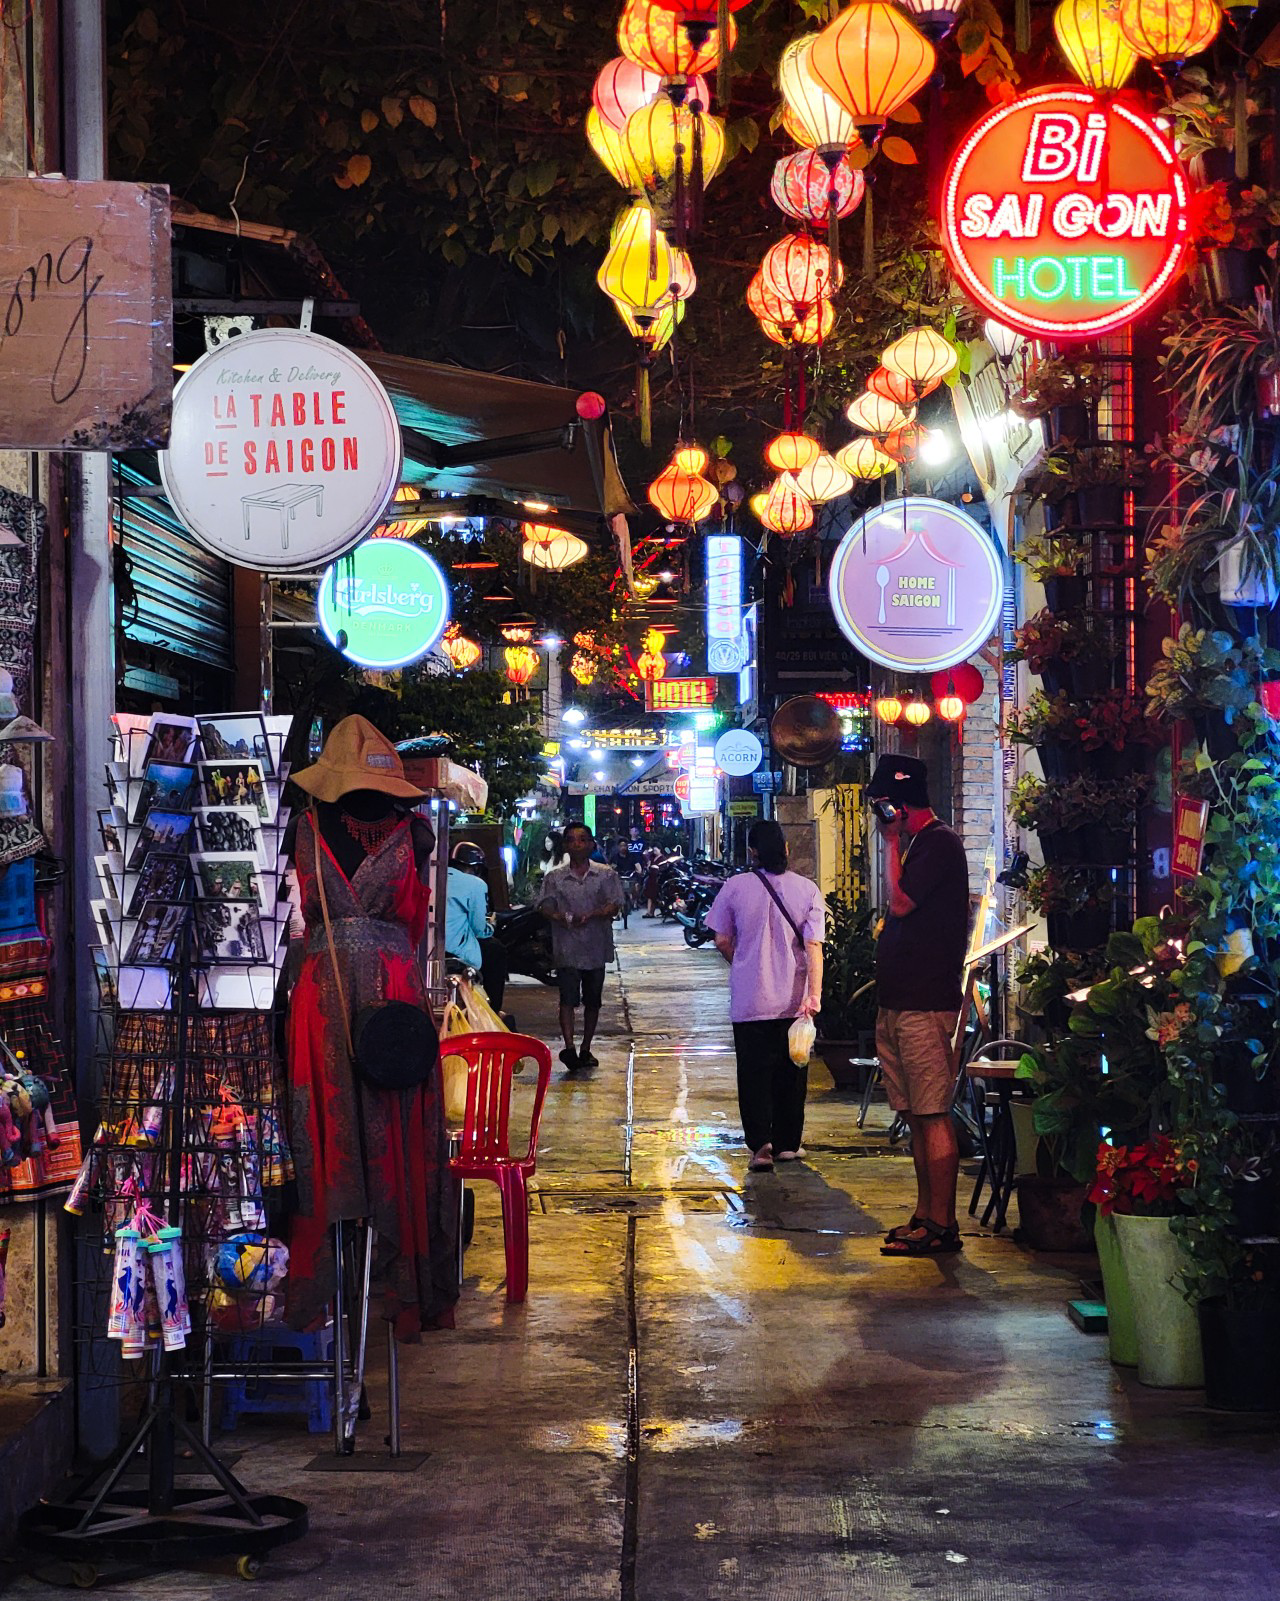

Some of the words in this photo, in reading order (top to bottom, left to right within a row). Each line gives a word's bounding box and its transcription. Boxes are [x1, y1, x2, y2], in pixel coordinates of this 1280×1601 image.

[1021, 113, 1107, 182] Bi
[960, 193, 1044, 238] SAI
[993, 256, 1141, 298] HOTEL
[216, 368, 264, 385] Kitchen
[268, 367, 282, 383] &
[287, 365, 342, 386] Delivery
[213, 395, 237, 419] LA
[250, 390, 346, 427] TABLE
[204, 441, 229, 465] DE
[243, 437, 359, 475] SAIGON
[336, 577, 434, 614] Carlsberg
[898, 576, 936, 590] HOME
[891, 594, 941, 608] SAIGON
[352, 621, 412, 633] DENMARK
[653, 681, 712, 707] HOTEL
[720, 753, 758, 762] ACORN
